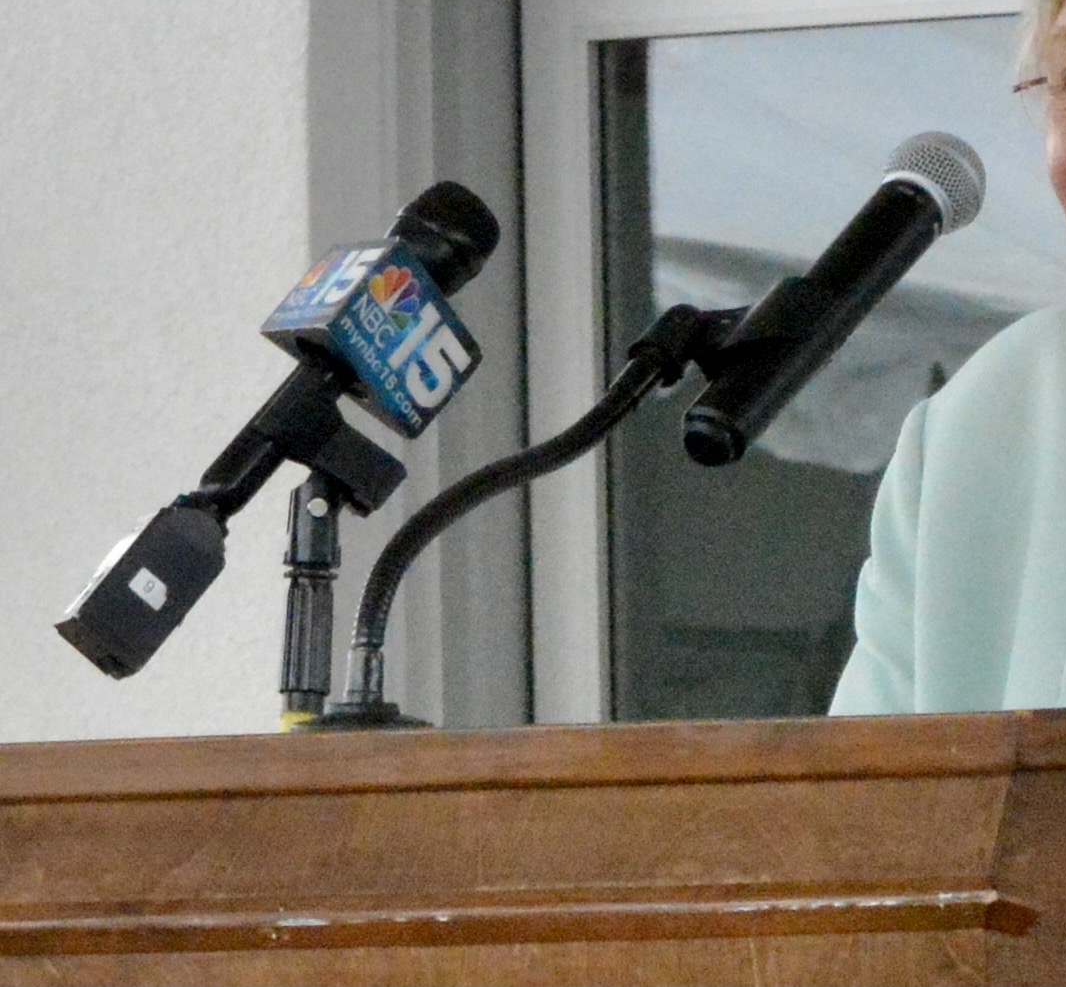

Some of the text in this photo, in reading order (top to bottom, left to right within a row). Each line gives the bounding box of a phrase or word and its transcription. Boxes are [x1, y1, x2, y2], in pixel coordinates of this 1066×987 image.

[311, 247, 386, 304] 15
[353, 293, 395, 349] NBC
[388, 301, 472, 409] 15
[340, 317, 423, 428] mynbc15.com
